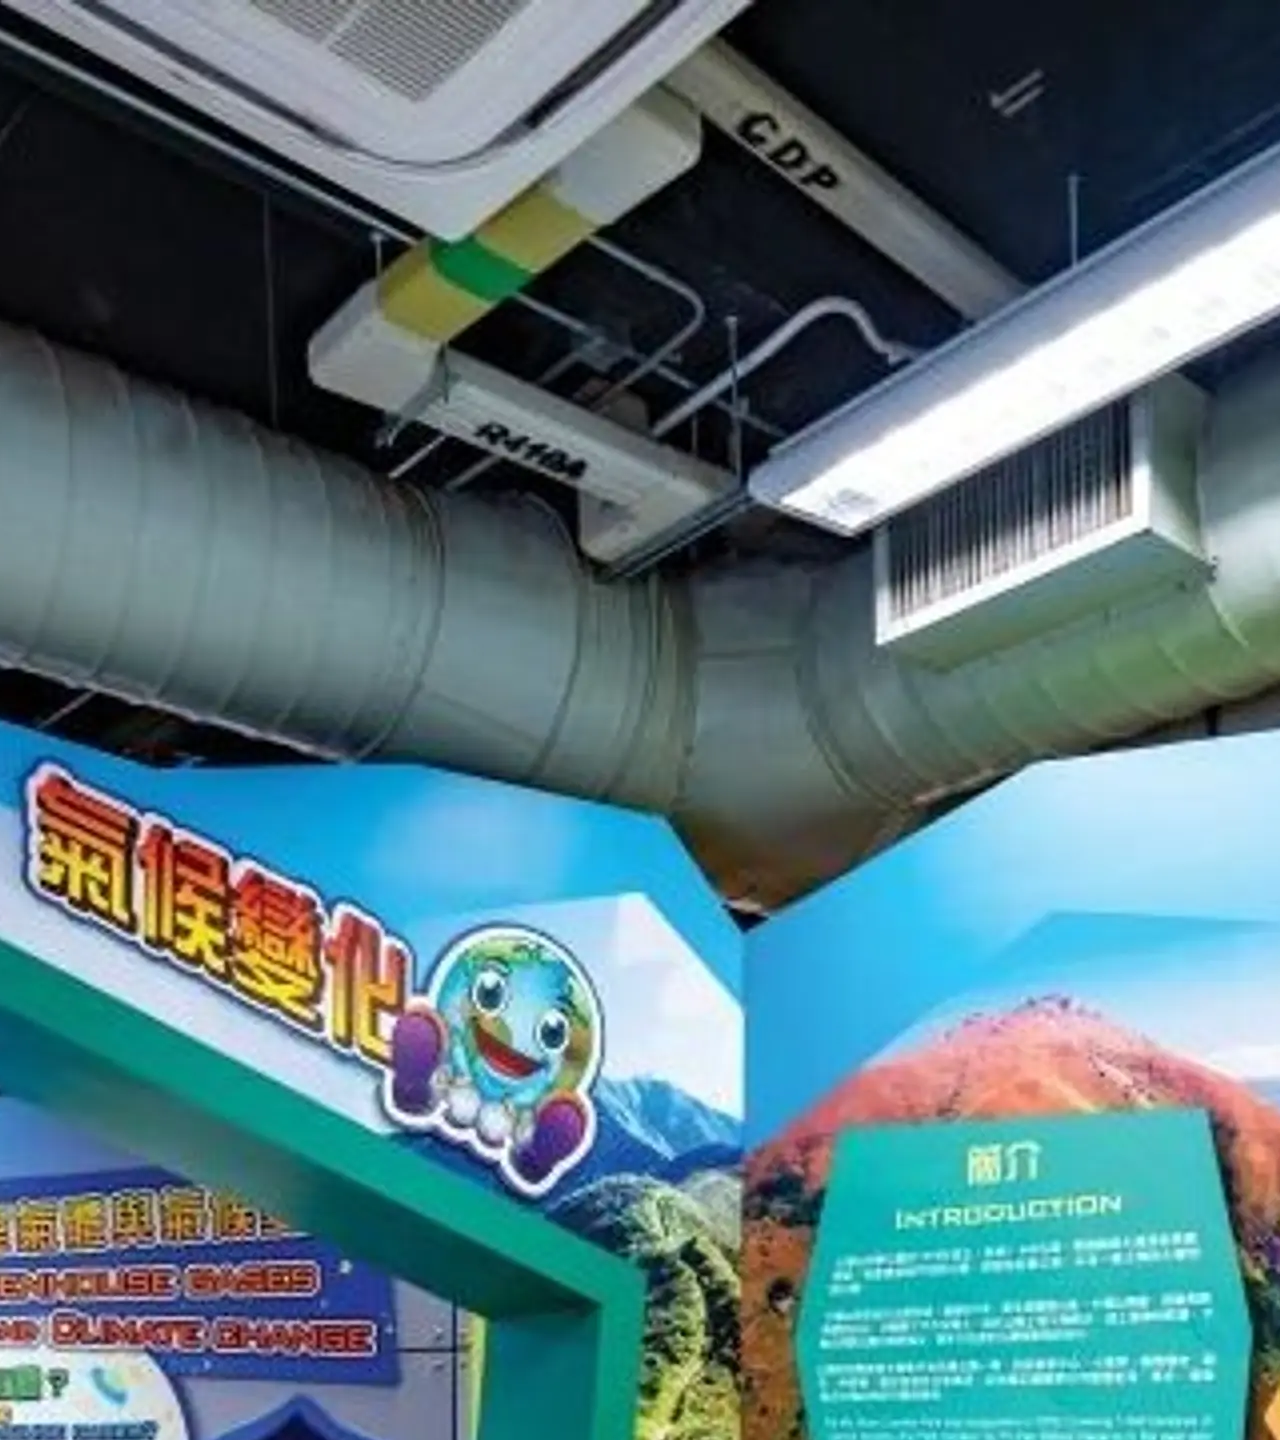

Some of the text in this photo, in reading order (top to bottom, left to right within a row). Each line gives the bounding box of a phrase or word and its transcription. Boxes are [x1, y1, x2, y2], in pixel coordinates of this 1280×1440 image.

[737, 110, 839, 190] CDP
[34, 772, 408, 1059] 氣候變化
[187, 1264, 316, 1298] GASES
[53, 1313, 202, 1347] CLIMATE
[214, 1321, 373, 1354] CHANGE
